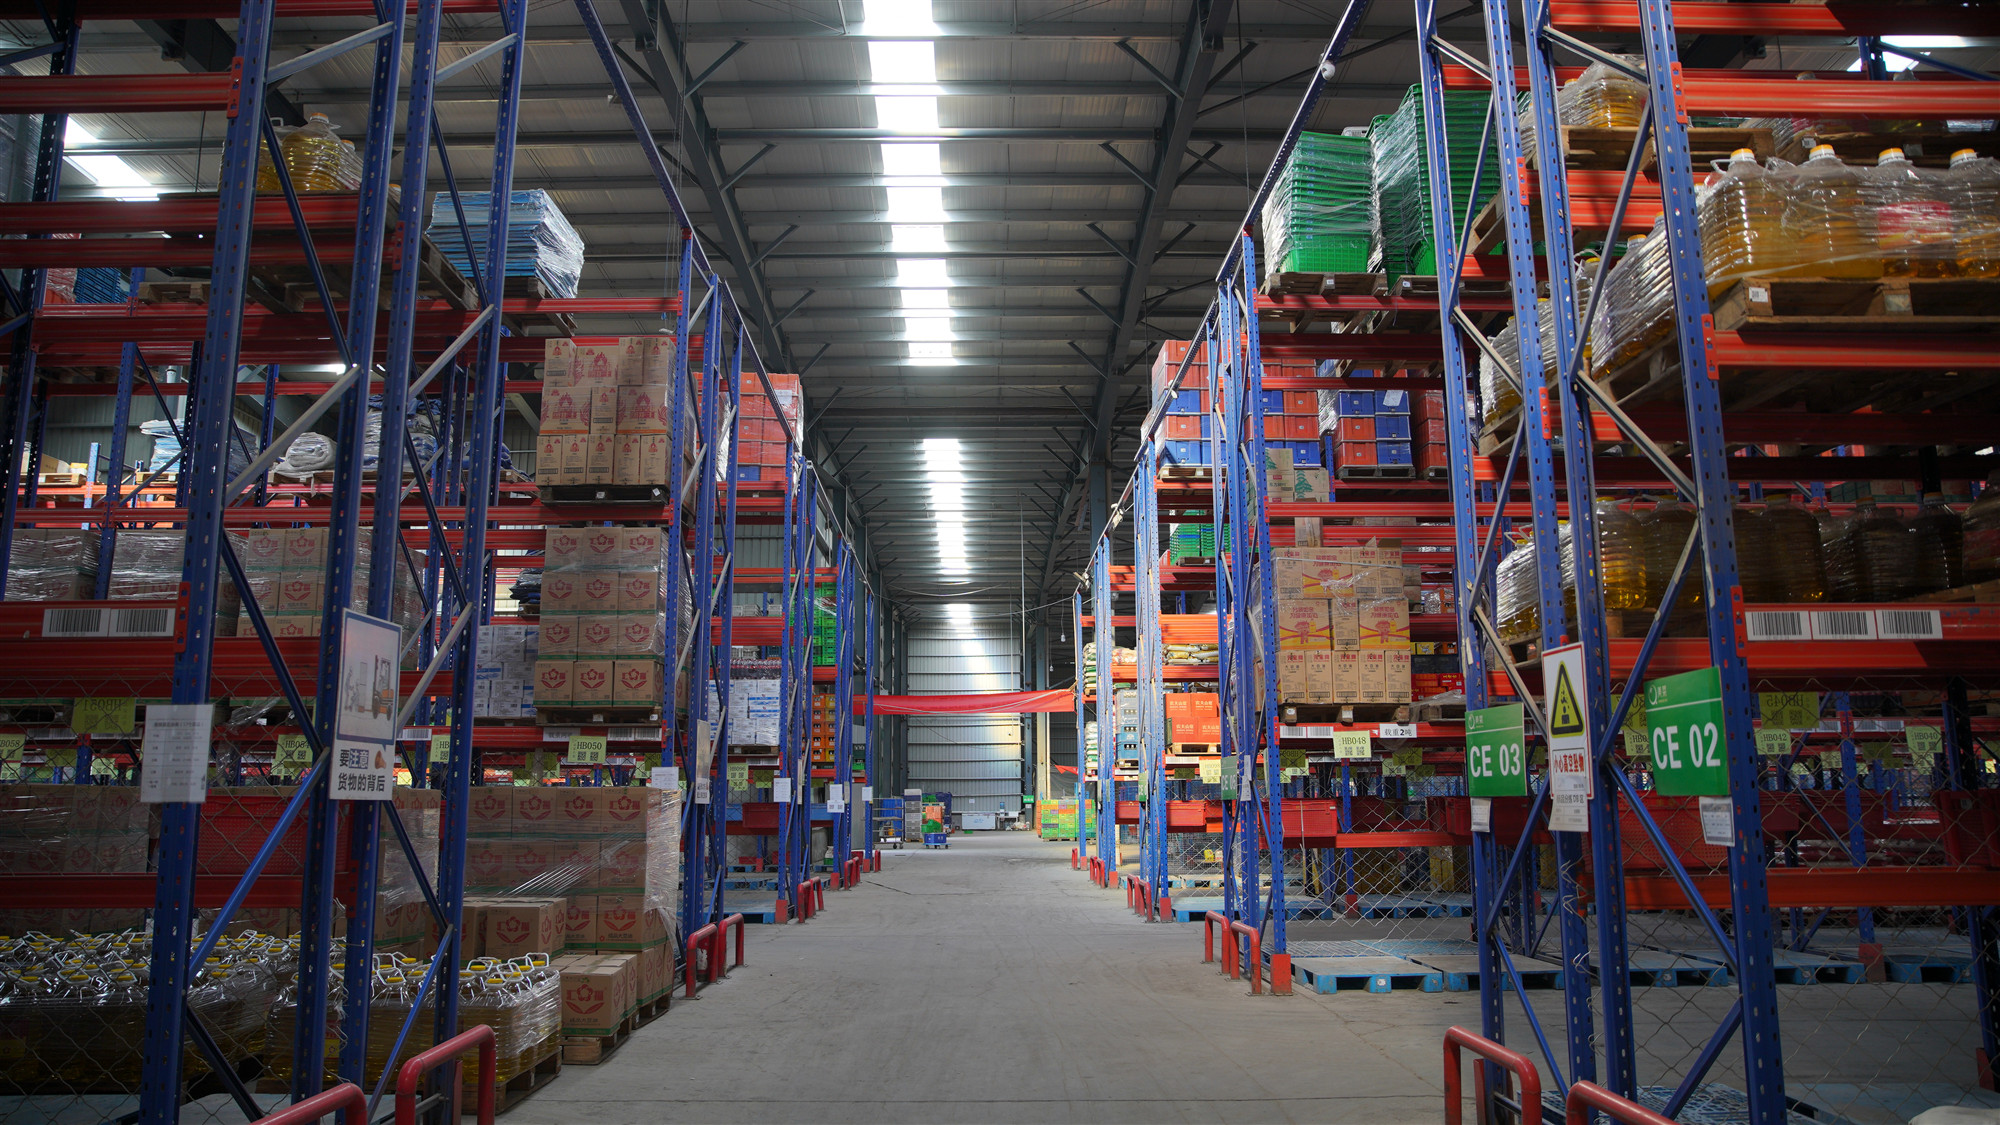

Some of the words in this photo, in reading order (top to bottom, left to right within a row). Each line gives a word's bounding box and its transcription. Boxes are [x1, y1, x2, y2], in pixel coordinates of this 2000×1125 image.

[1653, 726, 1682, 770] CE
[1689, 722, 1720, 768] 02
[1763, 734, 1787, 742] HB042
[1914, 732, 1938, 740] HB040
[340, 749, 368, 769] 要注意
[1470, 745, 1492, 777] CE
[1500, 743, 1521, 776] 03
[1553, 753, 1584, 773] 小心高空坠物
[338, 772, 385, 792] 货物的背后
[1221, 775, 1228, 790] CE
[566, 988, 604, 1000] 汇福
